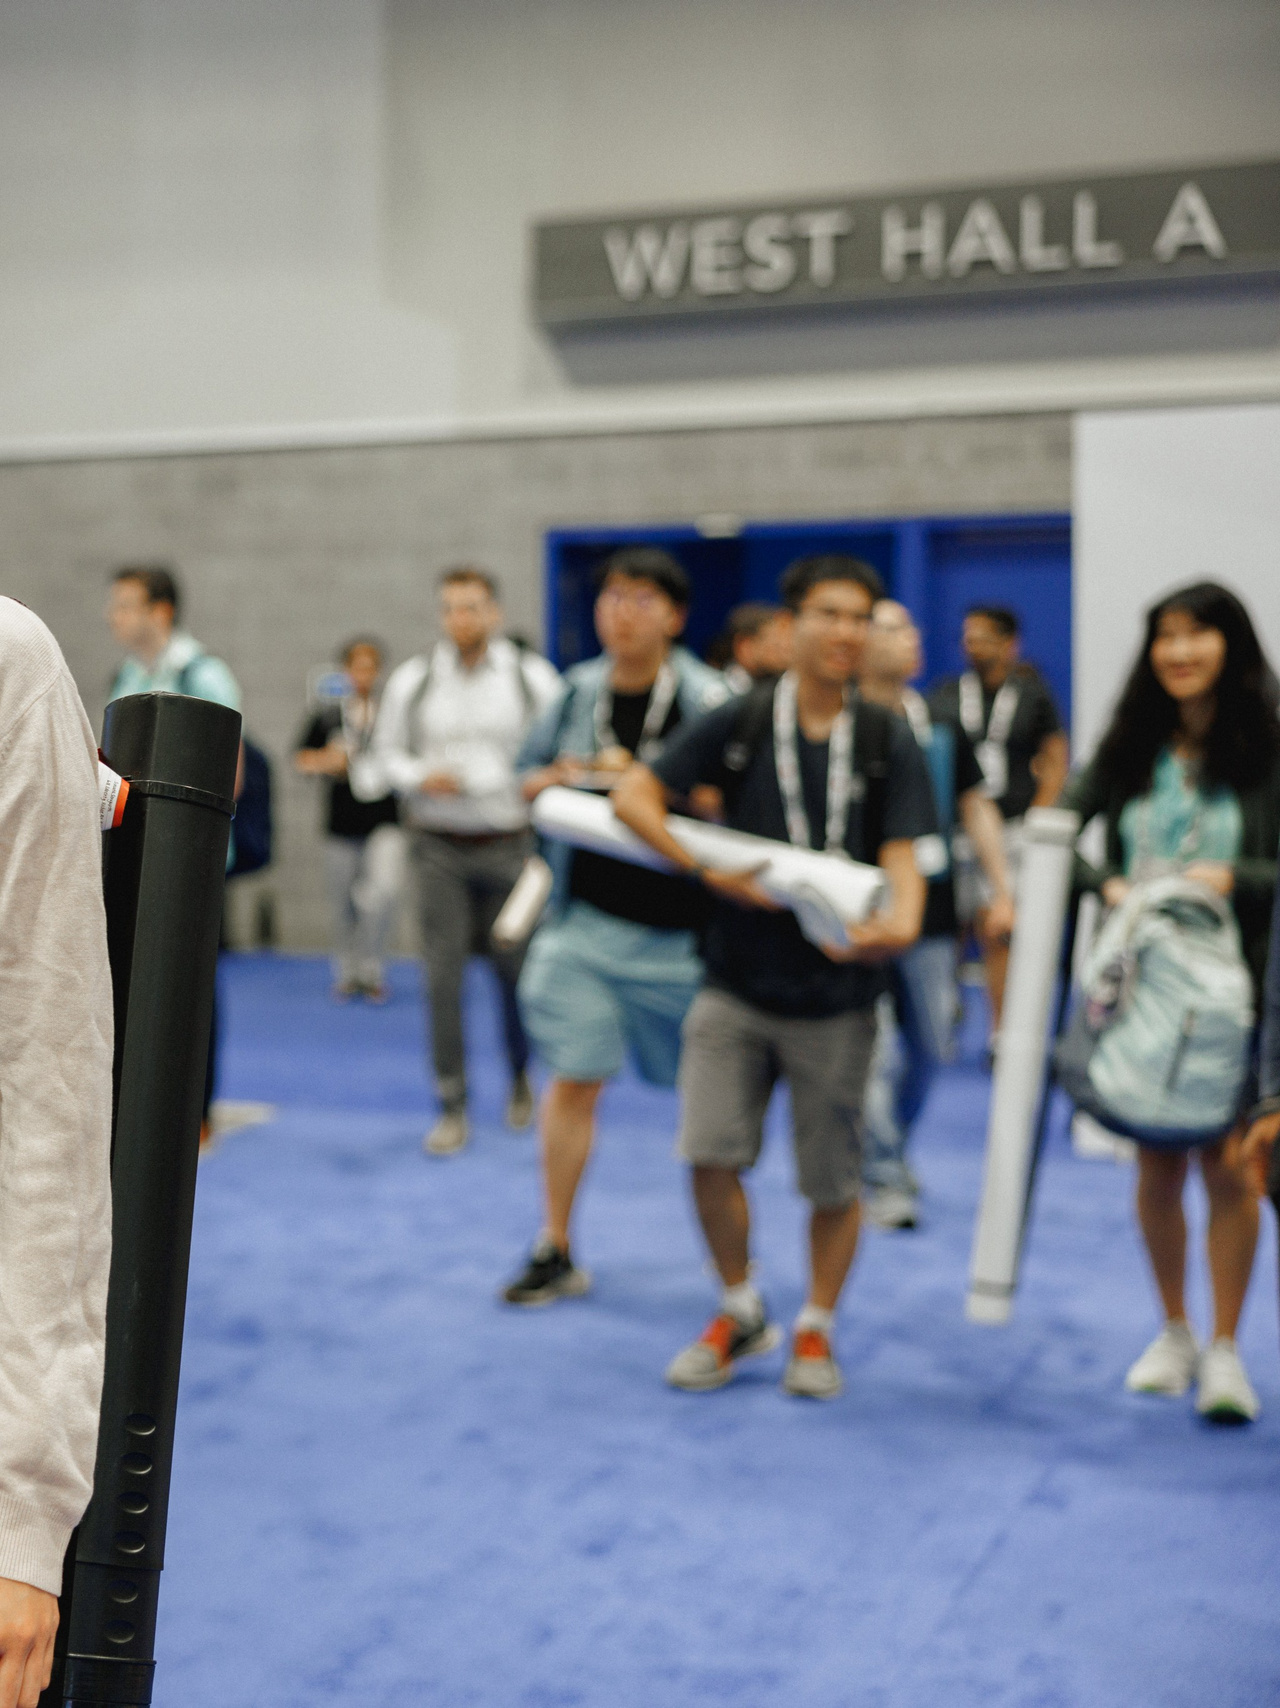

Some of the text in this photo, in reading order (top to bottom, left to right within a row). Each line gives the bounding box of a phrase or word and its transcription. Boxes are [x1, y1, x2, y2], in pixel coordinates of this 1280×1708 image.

[602, 180, 1228, 302] WEST HALL A
